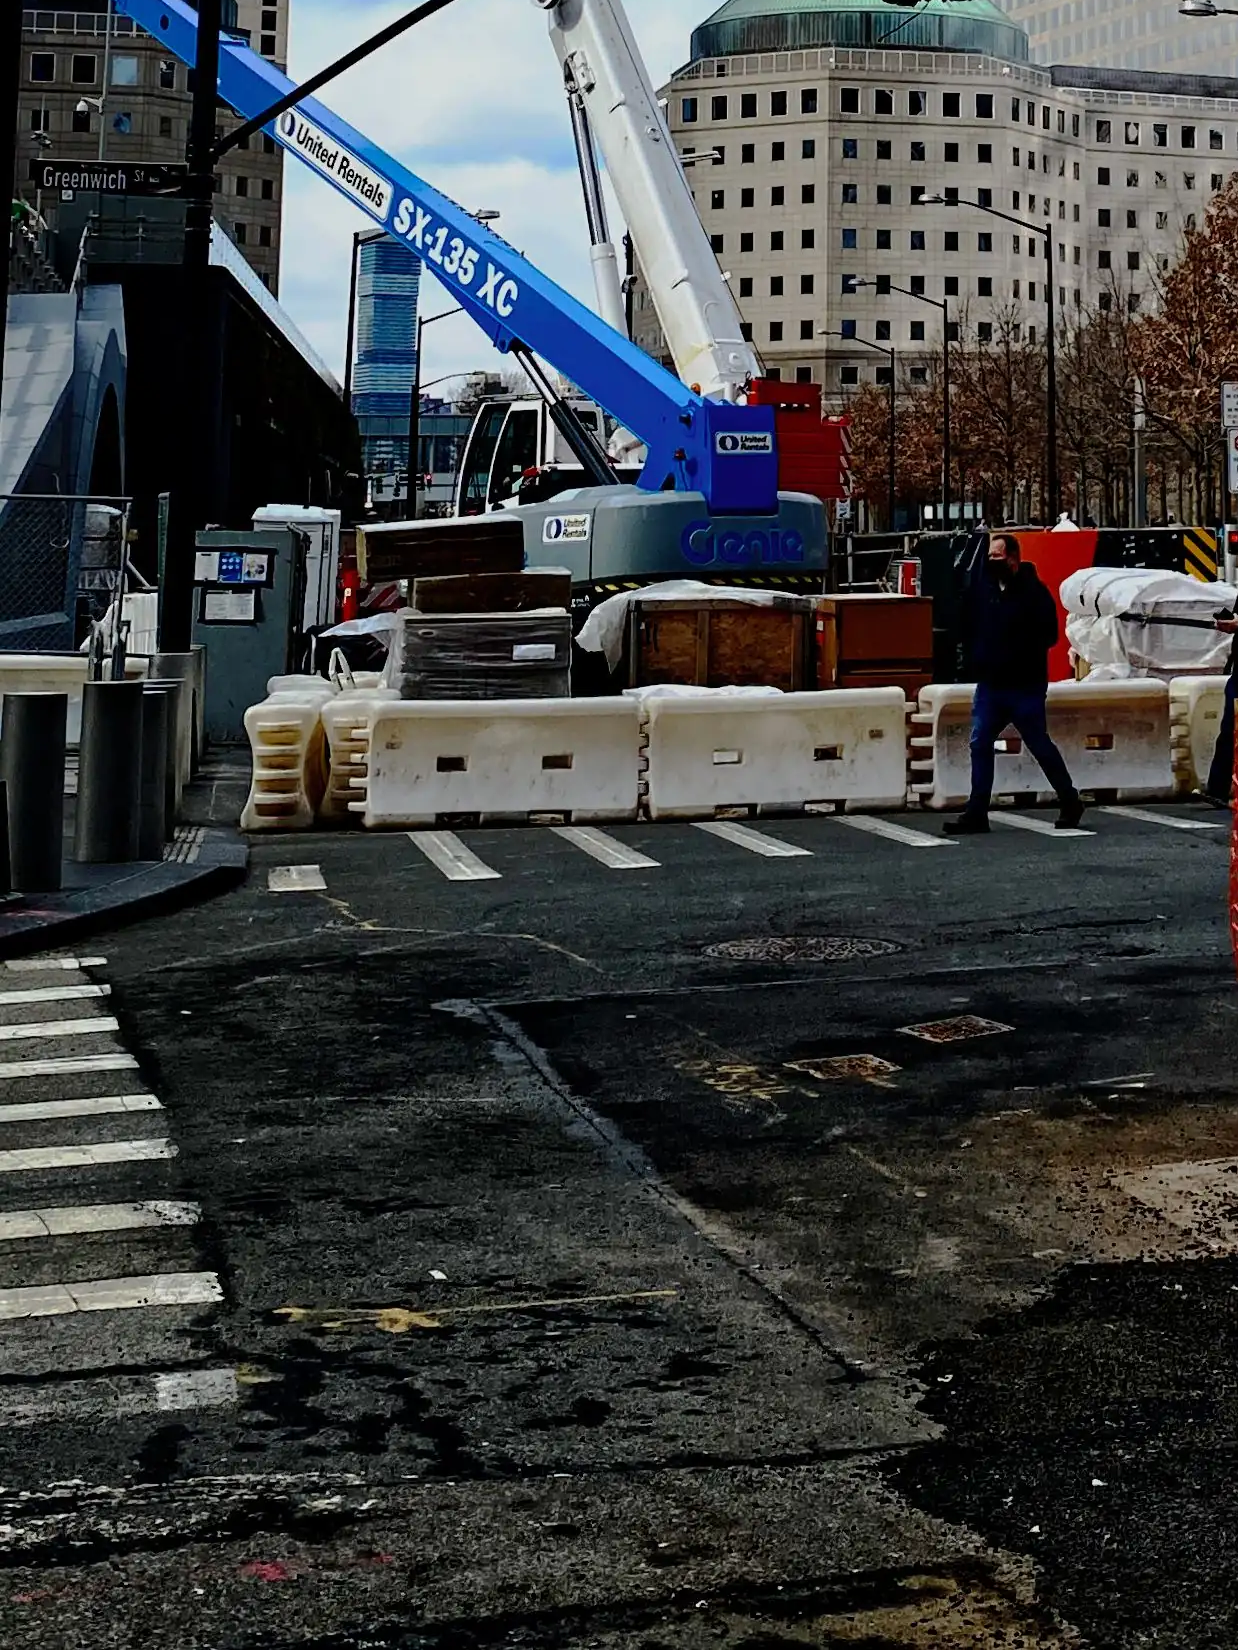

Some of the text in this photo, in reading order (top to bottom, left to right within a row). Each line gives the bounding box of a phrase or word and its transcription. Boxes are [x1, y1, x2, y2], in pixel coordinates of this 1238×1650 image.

[43, 166, 126, 190] Greenwich
[134, 170, 144, 182] St
[296, 123, 384, 208] United Rentals
[393, 198, 518, 317] SX-135 XC
[680, 520, 804, 566] Genie
